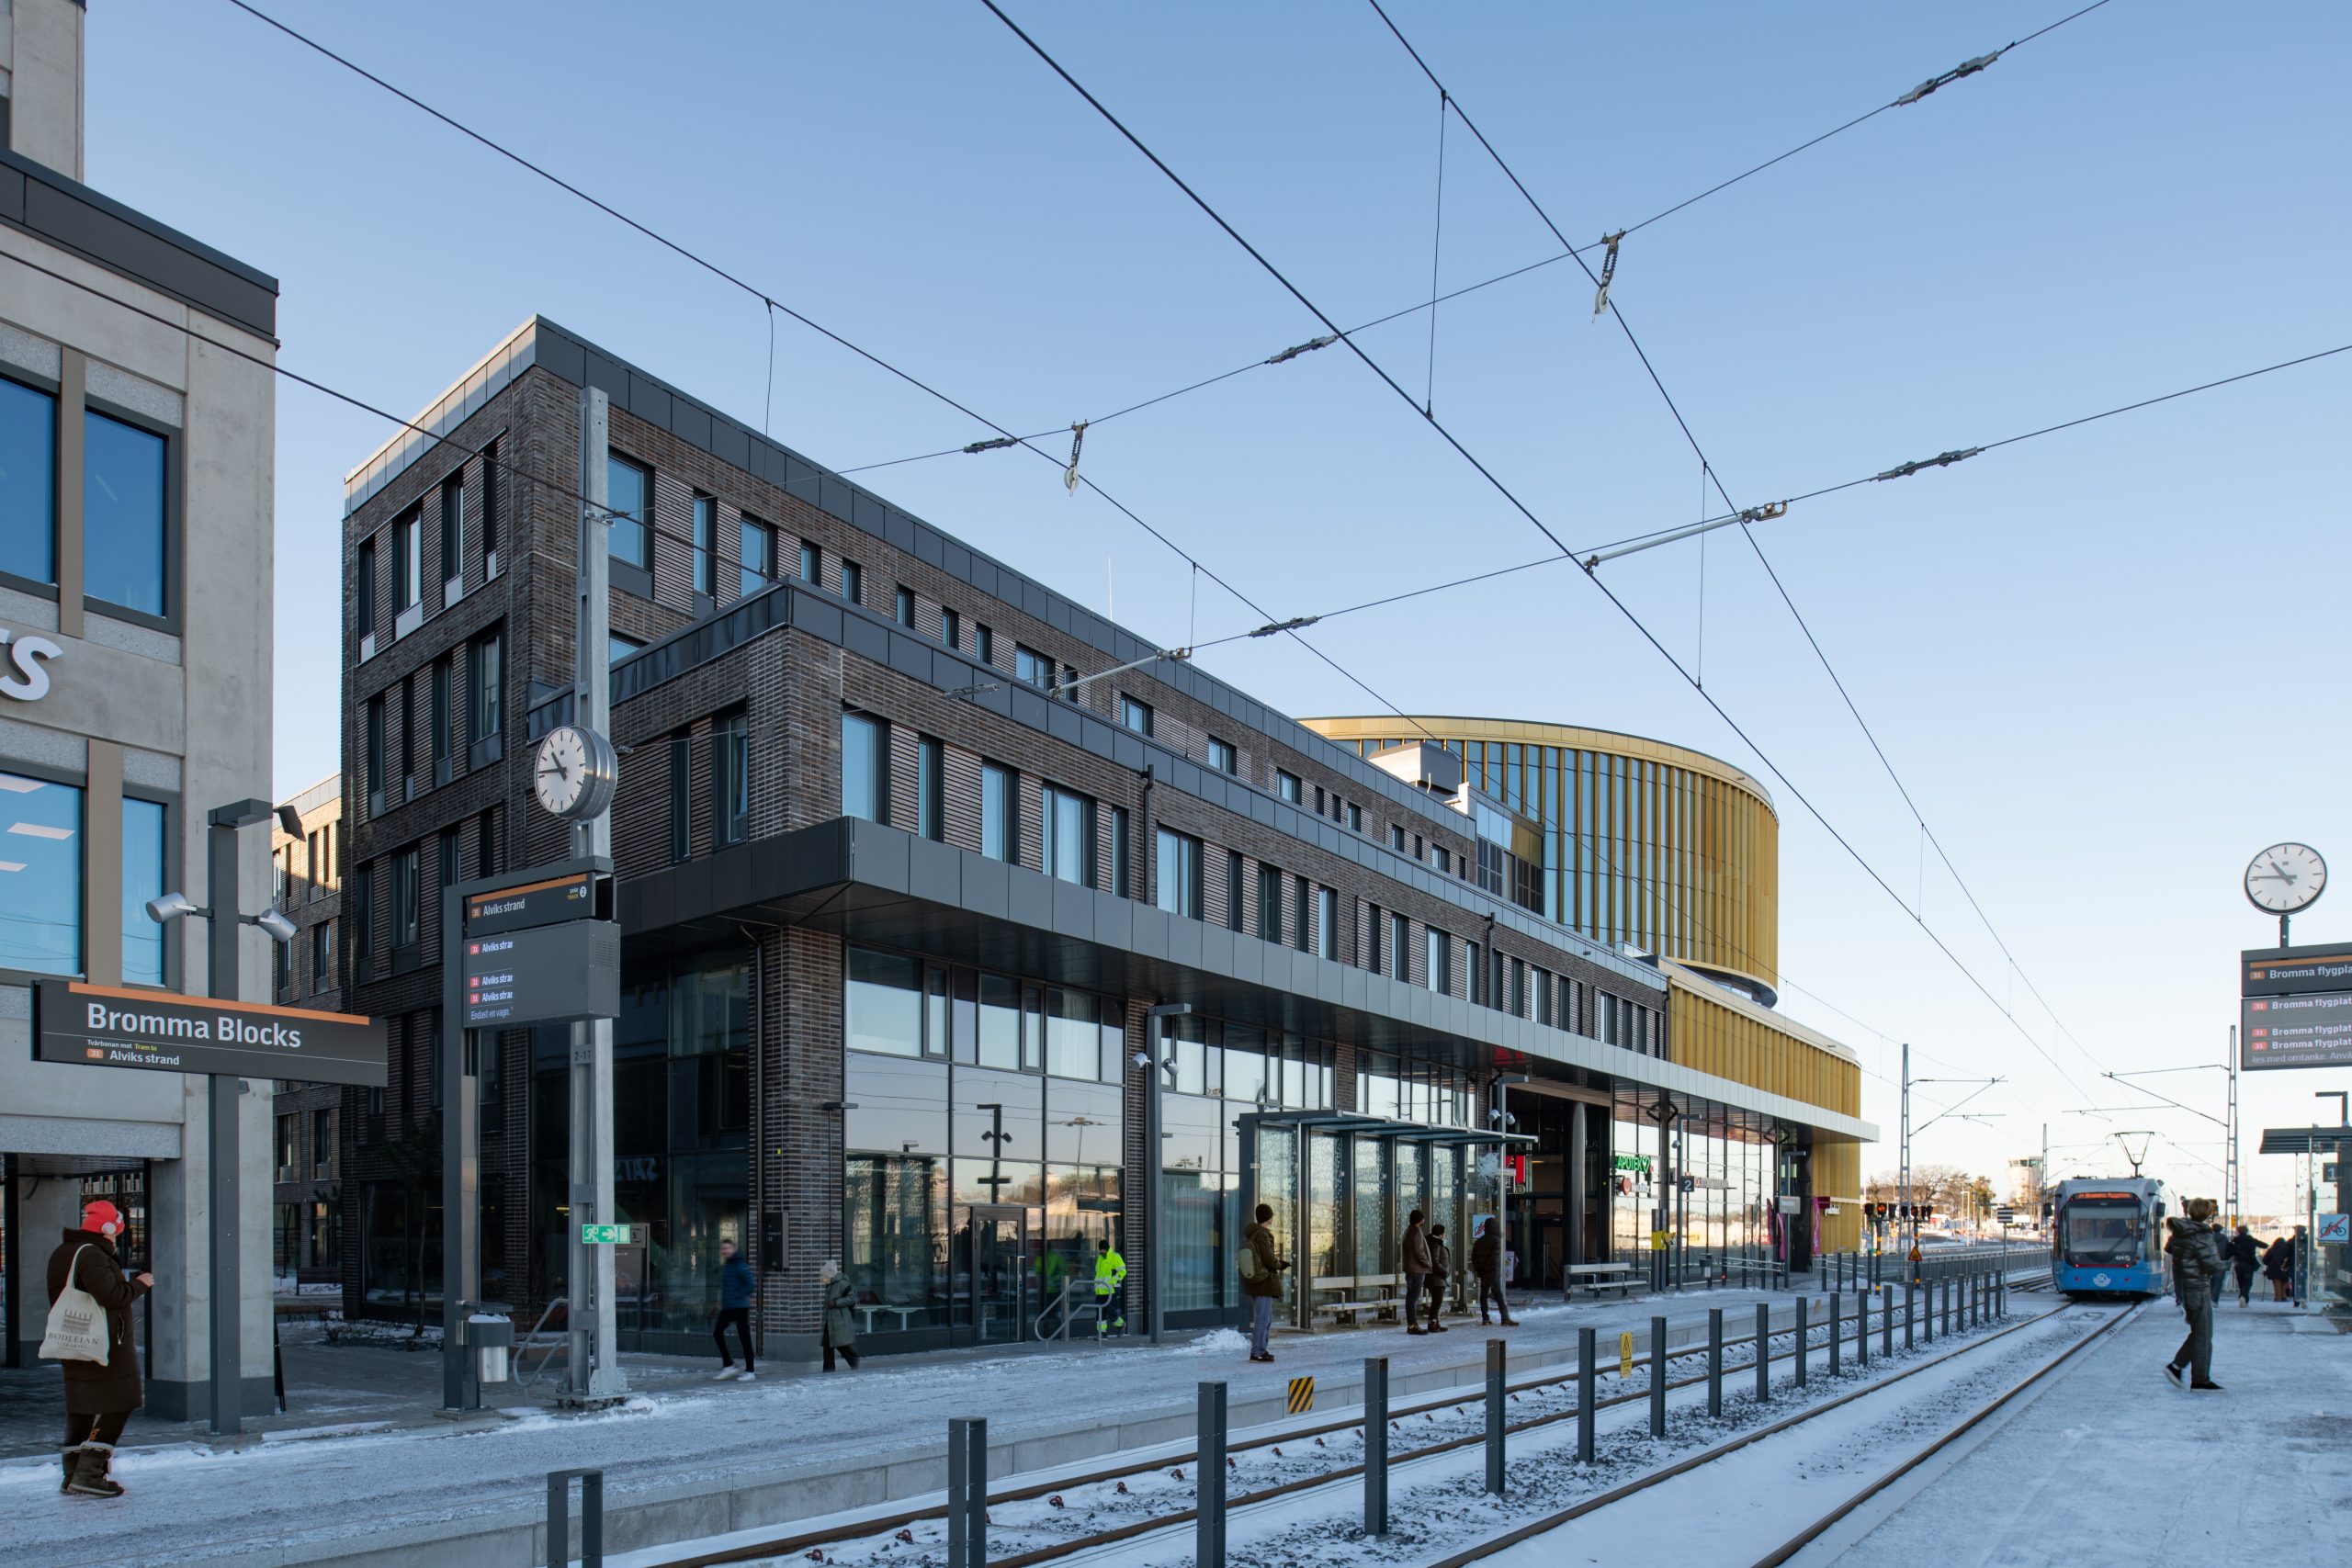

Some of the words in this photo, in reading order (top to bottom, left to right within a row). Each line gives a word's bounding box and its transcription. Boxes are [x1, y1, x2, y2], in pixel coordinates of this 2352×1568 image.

[483, 904, 503, 917] Alviks
[503, 898, 525, 912] strand
[482, 942, 499, 953] Alviks
[2269, 969, 2315, 979] Bromma
[482, 975, 499, 986] Alviks
[482, 991, 499, 1002] Alviks
[2272, 1000, 2312, 1010] Bromma
[87, 1002, 209, 1040] Bromma
[218, 1016, 301, 1048] Blocks
[2272, 1027, 2312, 1036] Bromma
[87, 1039, 119, 1049] Tvärbanan
[2272, 1041, 2312, 1049] Bromma
[109, 1050, 143, 1063] Alviks
[145, 1054, 180, 1066] strand
[574, 1050, 592, 1061] 2-17
[2267, 1054, 2286, 1063] med
[1617, 1156, 1643, 1171] APOTEK
[2327, 1167, 2336, 1180] 1
[1684, 1179, 1692, 1190] 2
[49, 1332, 98, 1345] BODLEIAN
